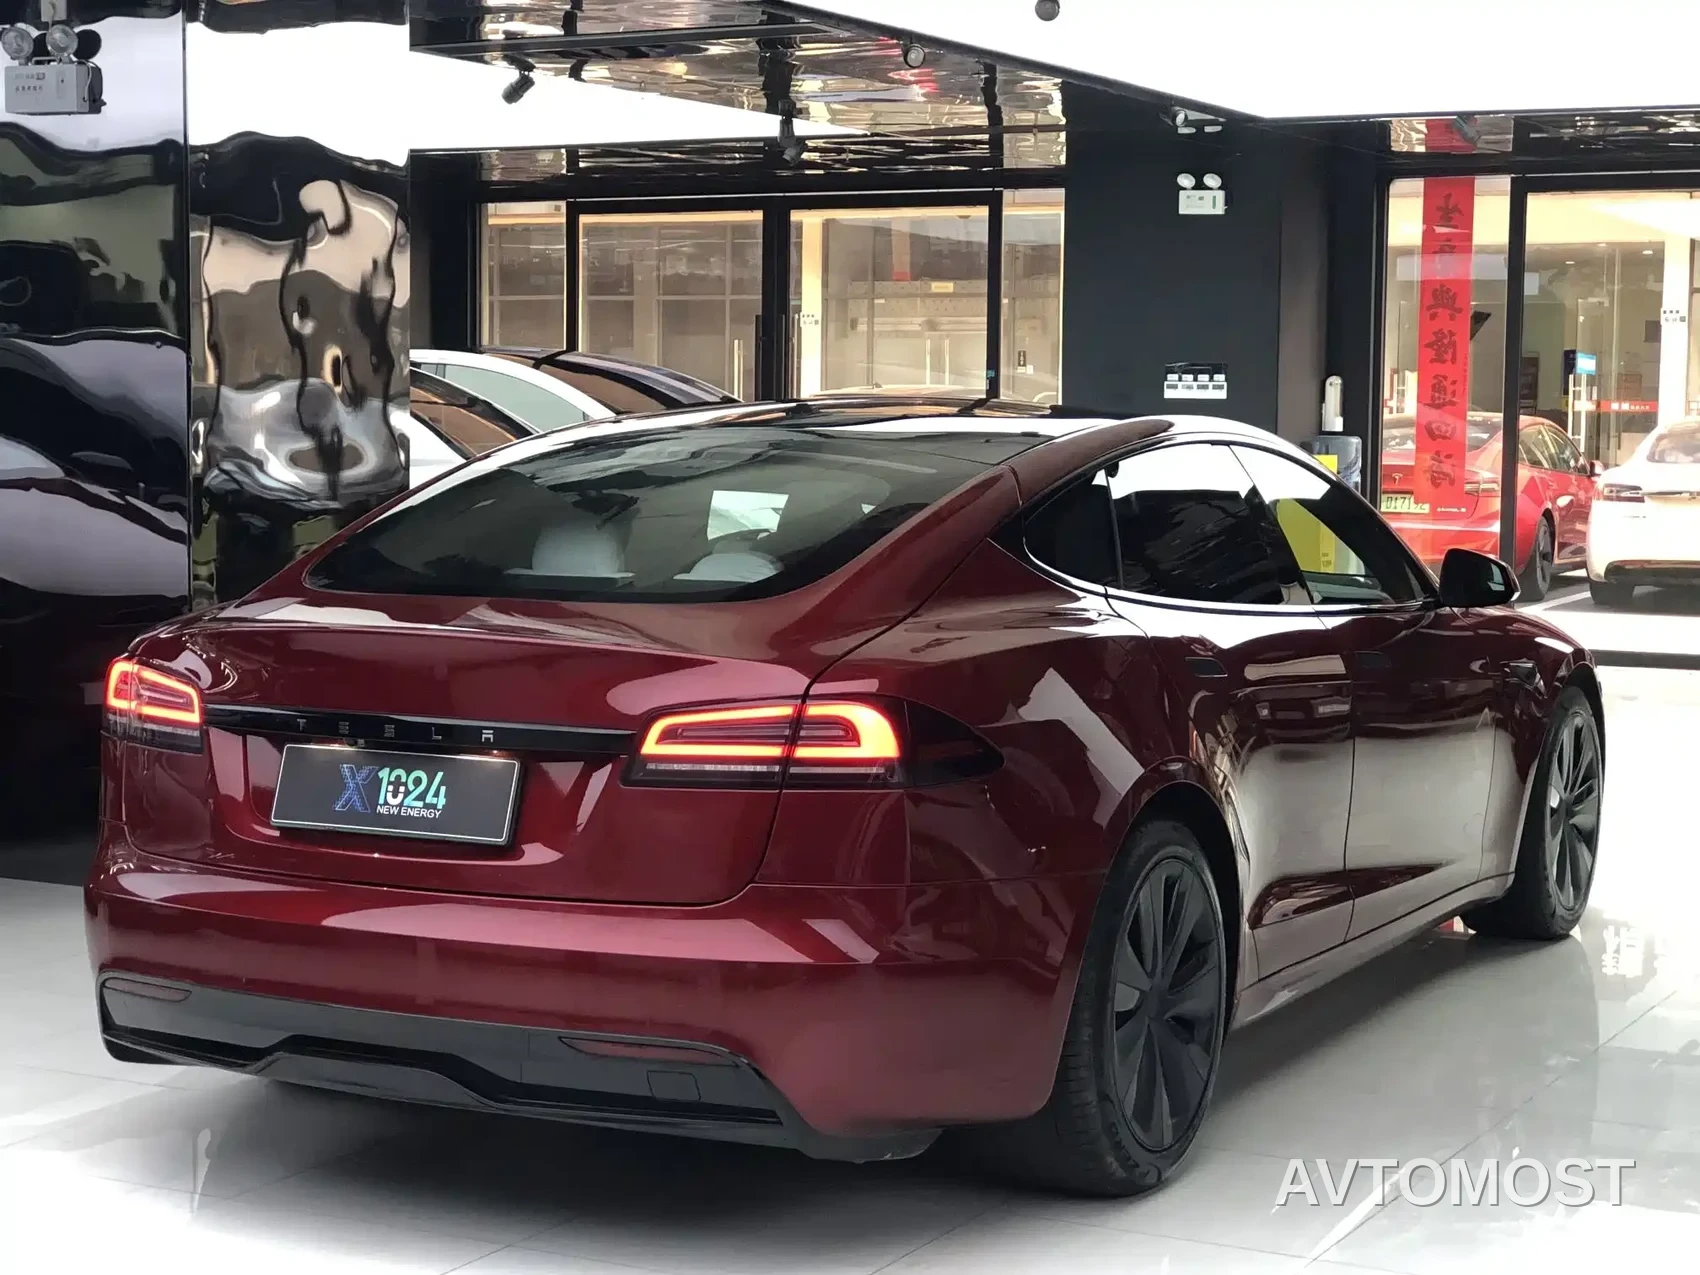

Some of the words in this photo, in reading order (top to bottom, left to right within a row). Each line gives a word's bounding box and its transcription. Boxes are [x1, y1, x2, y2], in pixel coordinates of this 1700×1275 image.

[296, 718, 495, 743] TESLA
[376, 804, 400, 815] NEW
[400, 807, 443, 819] ENERGY
